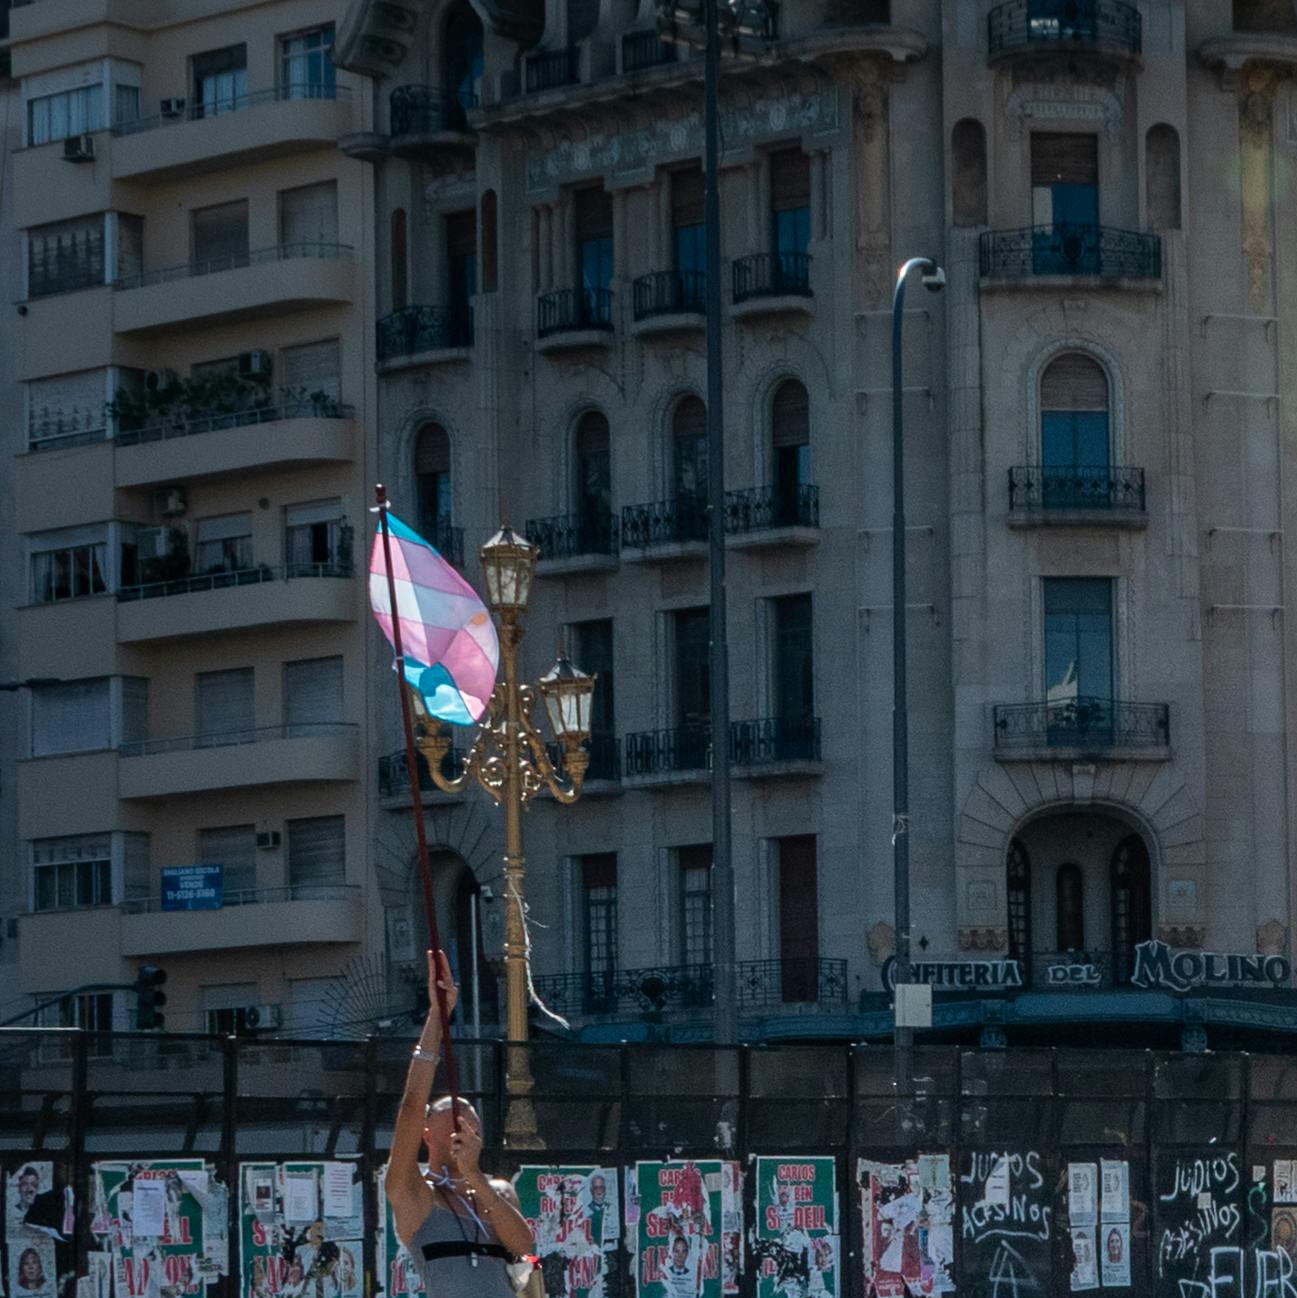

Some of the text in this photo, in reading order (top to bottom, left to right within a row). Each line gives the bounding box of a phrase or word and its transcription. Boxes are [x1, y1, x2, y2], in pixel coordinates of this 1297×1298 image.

[881, 939, 1291, 992] CNFITERIA DEL MOLINO
[778, 1164, 815, 1181] CARLOS
